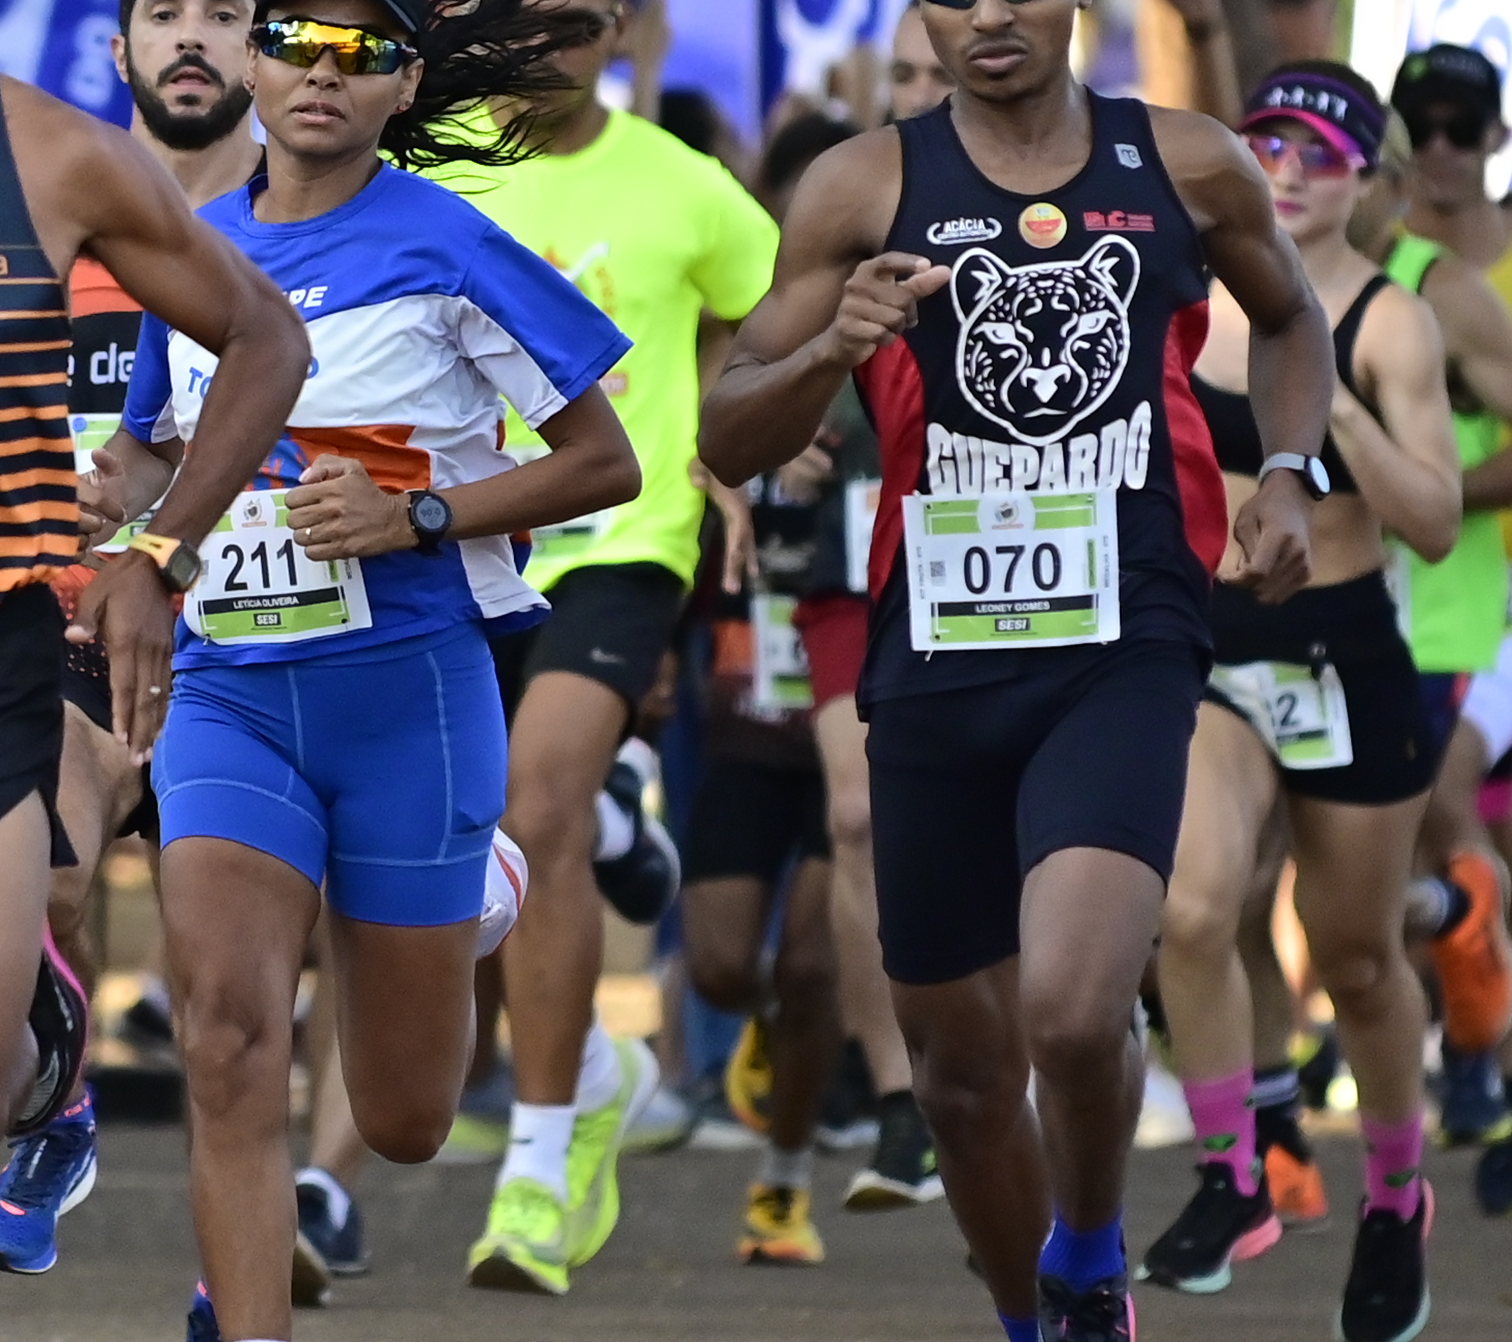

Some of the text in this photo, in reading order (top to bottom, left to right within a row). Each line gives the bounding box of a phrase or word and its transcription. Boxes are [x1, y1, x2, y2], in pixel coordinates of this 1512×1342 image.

[943, 216, 987, 233] ACÁCIA
[926, 401, 1152, 495] GUEPARDO
[221, 539, 297, 592] 211
[964, 542, 1062, 595] 070
[233, 596, 299, 609] LETÍCIA OLIVEIRA
[975, 602, 1050, 613] LEONEY GOMES
[256, 614, 278, 625] SESI
[997, 619, 1027, 630] SESI
